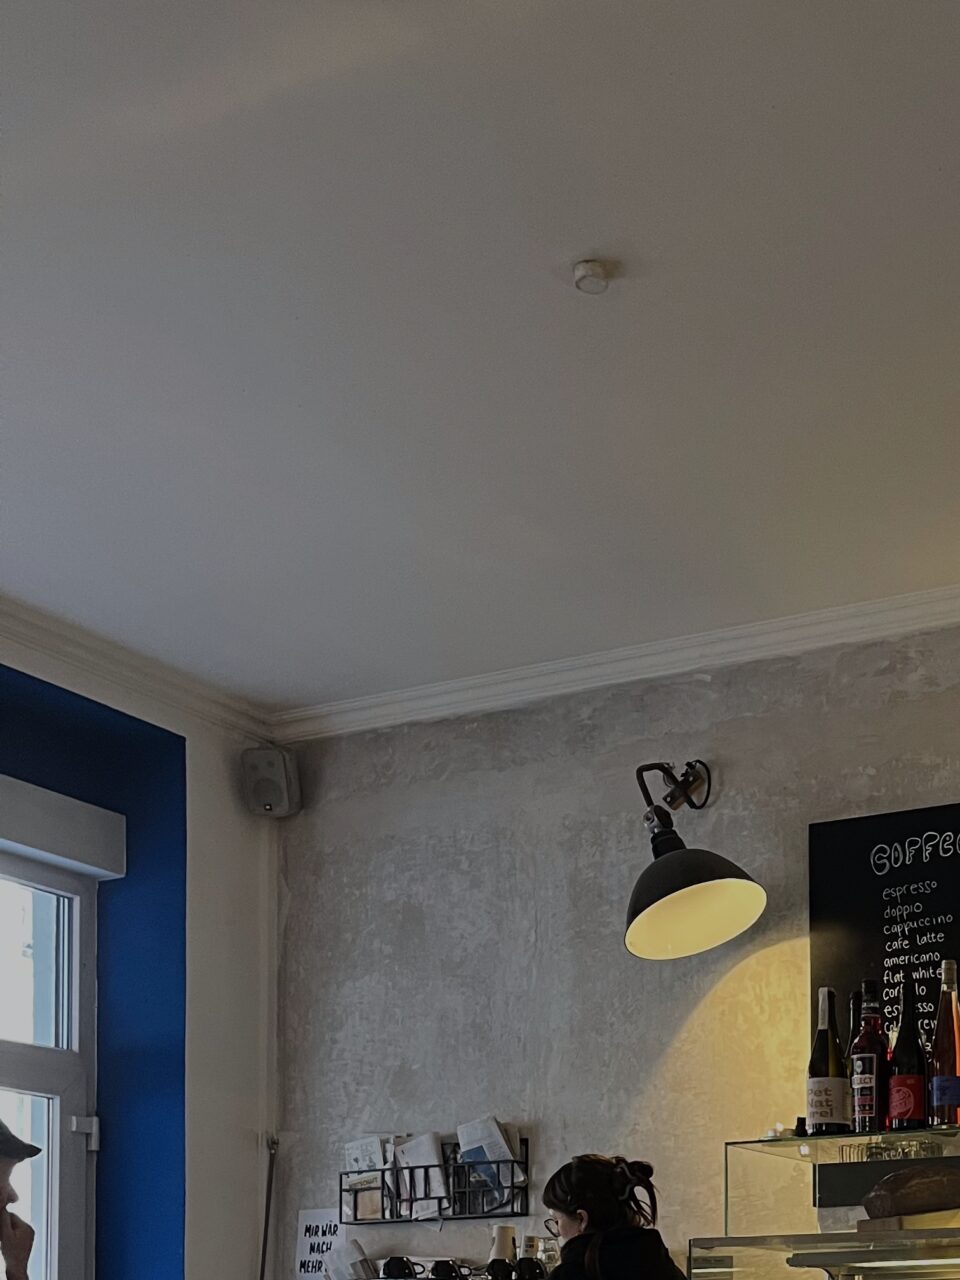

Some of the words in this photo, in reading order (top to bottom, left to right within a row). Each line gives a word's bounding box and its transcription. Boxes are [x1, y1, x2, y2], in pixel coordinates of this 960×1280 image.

[882, 880, 938, 903] espresso
[883, 903, 923, 921] doppio
[883, 914, 953, 936] cappuccino
[916, 931, 945, 946] latte
[883, 951, 941, 967] americano
[882, 969, 905, 984] flat
[912, 966, 943, 979] white
[304, 1224, 319, 1238] MIR
[309, 1241, 332, 1255] NACH
